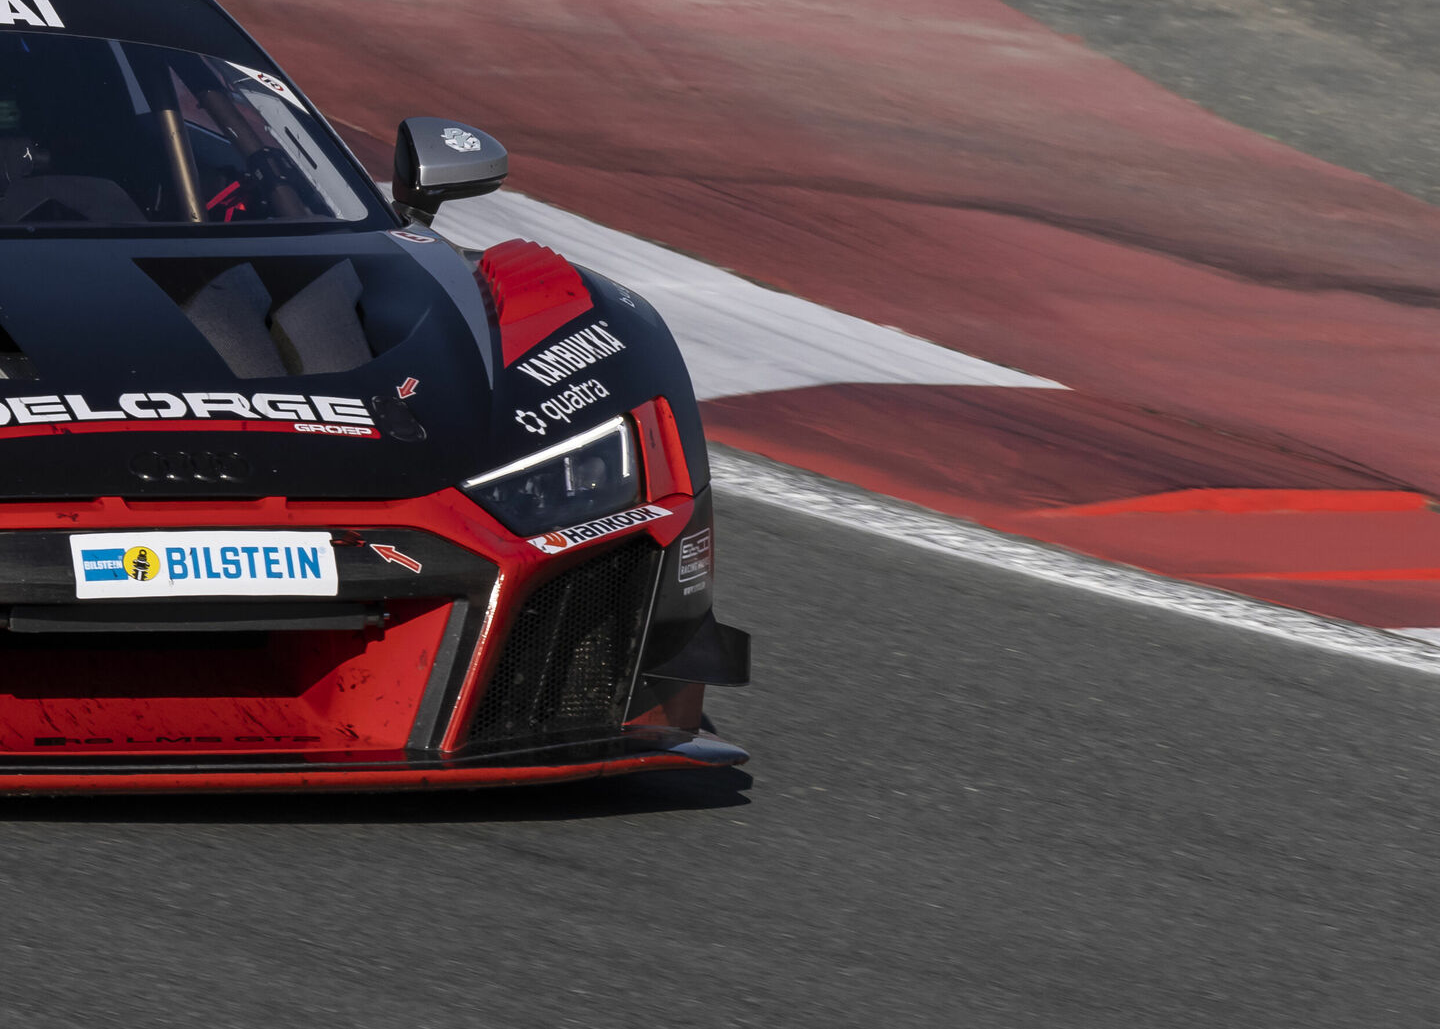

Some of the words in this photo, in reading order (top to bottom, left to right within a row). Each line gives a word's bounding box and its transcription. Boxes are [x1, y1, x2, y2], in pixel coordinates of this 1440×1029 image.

[516, 322, 627, 387] KAMBUKKA
[540, 377, 611, 424] quatra
[293, 423, 373, 436] GROEP
[83, 559, 124, 571] BILSTEIN
[165, 546, 323, 580] BILSTEIN
